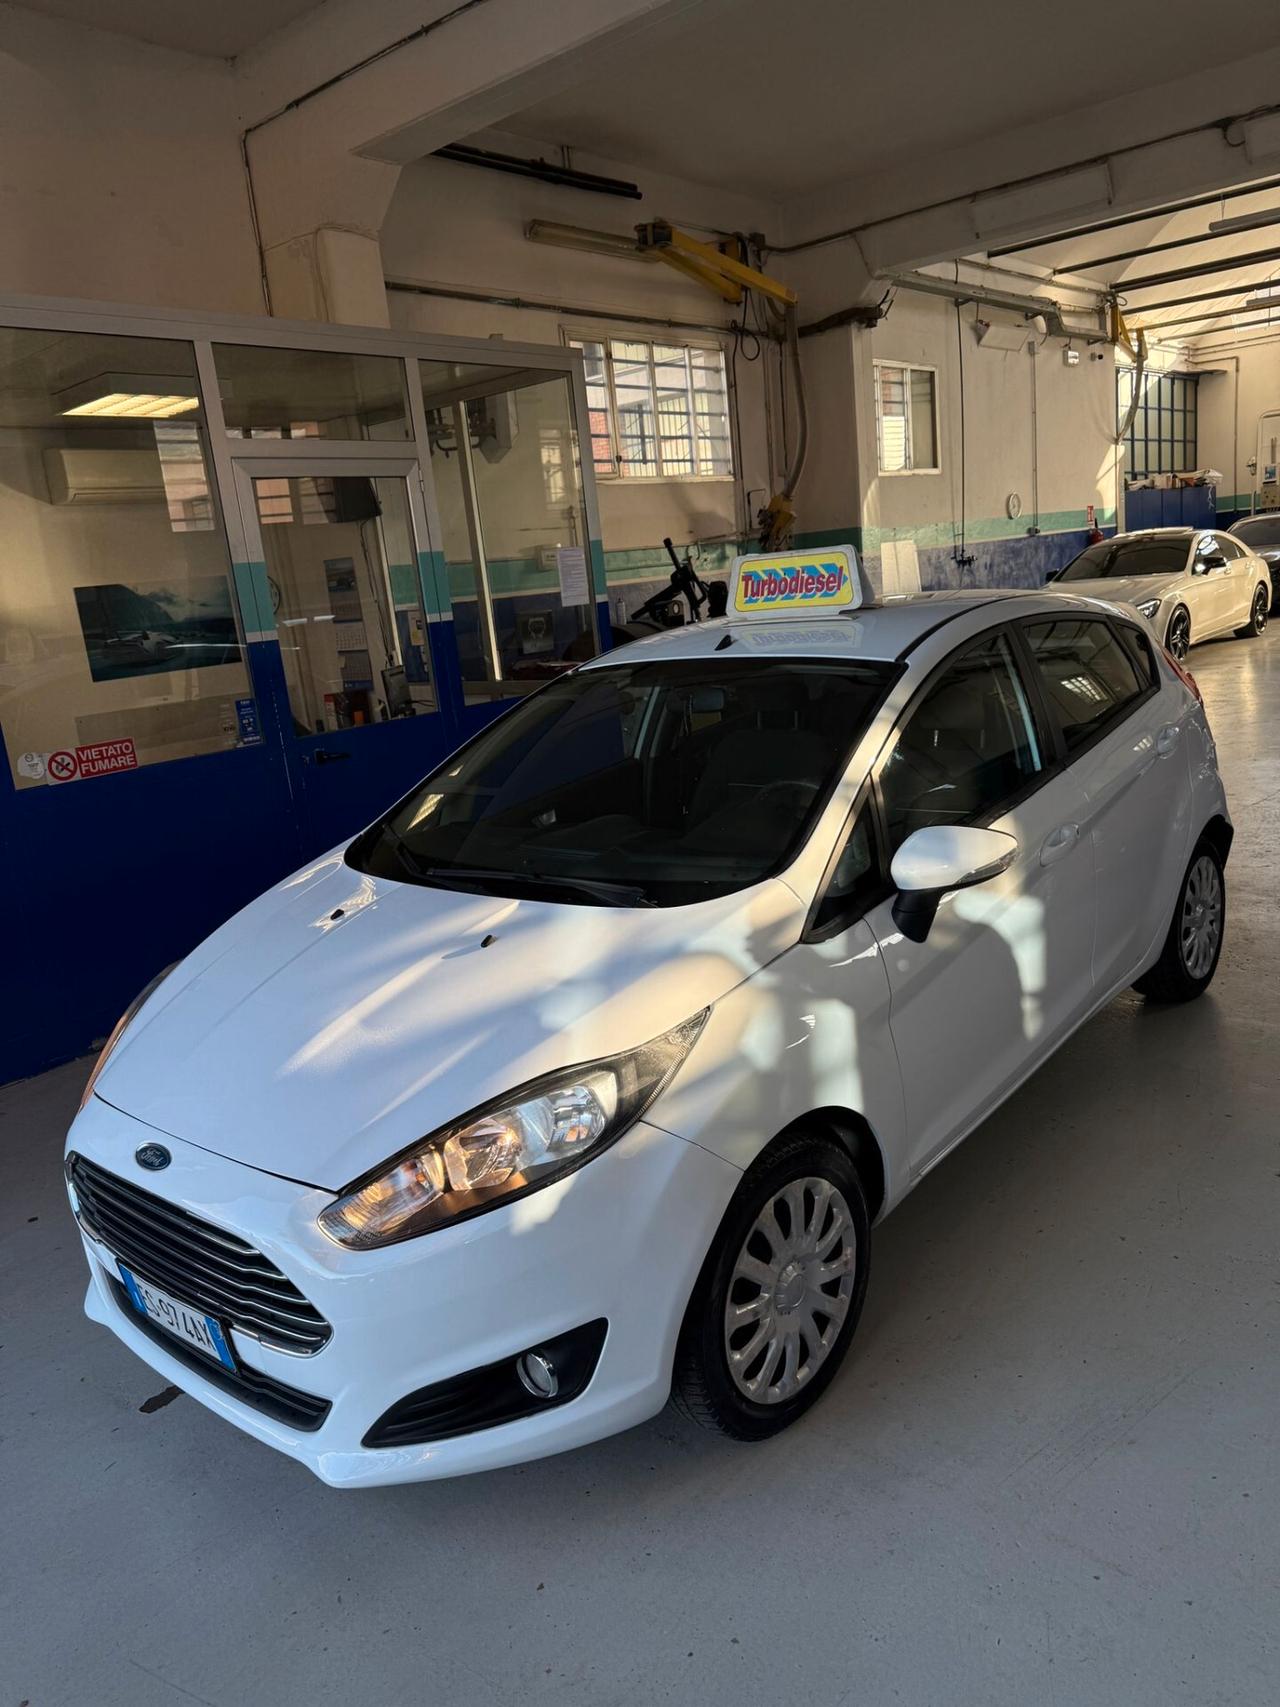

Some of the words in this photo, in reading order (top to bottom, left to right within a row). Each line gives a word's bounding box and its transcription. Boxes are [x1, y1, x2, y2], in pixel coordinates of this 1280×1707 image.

[741, 566, 844, 598] Turbodiesel
[78, 742, 133, 761] VIETATO
[81, 754, 136, 774] FUMARE
